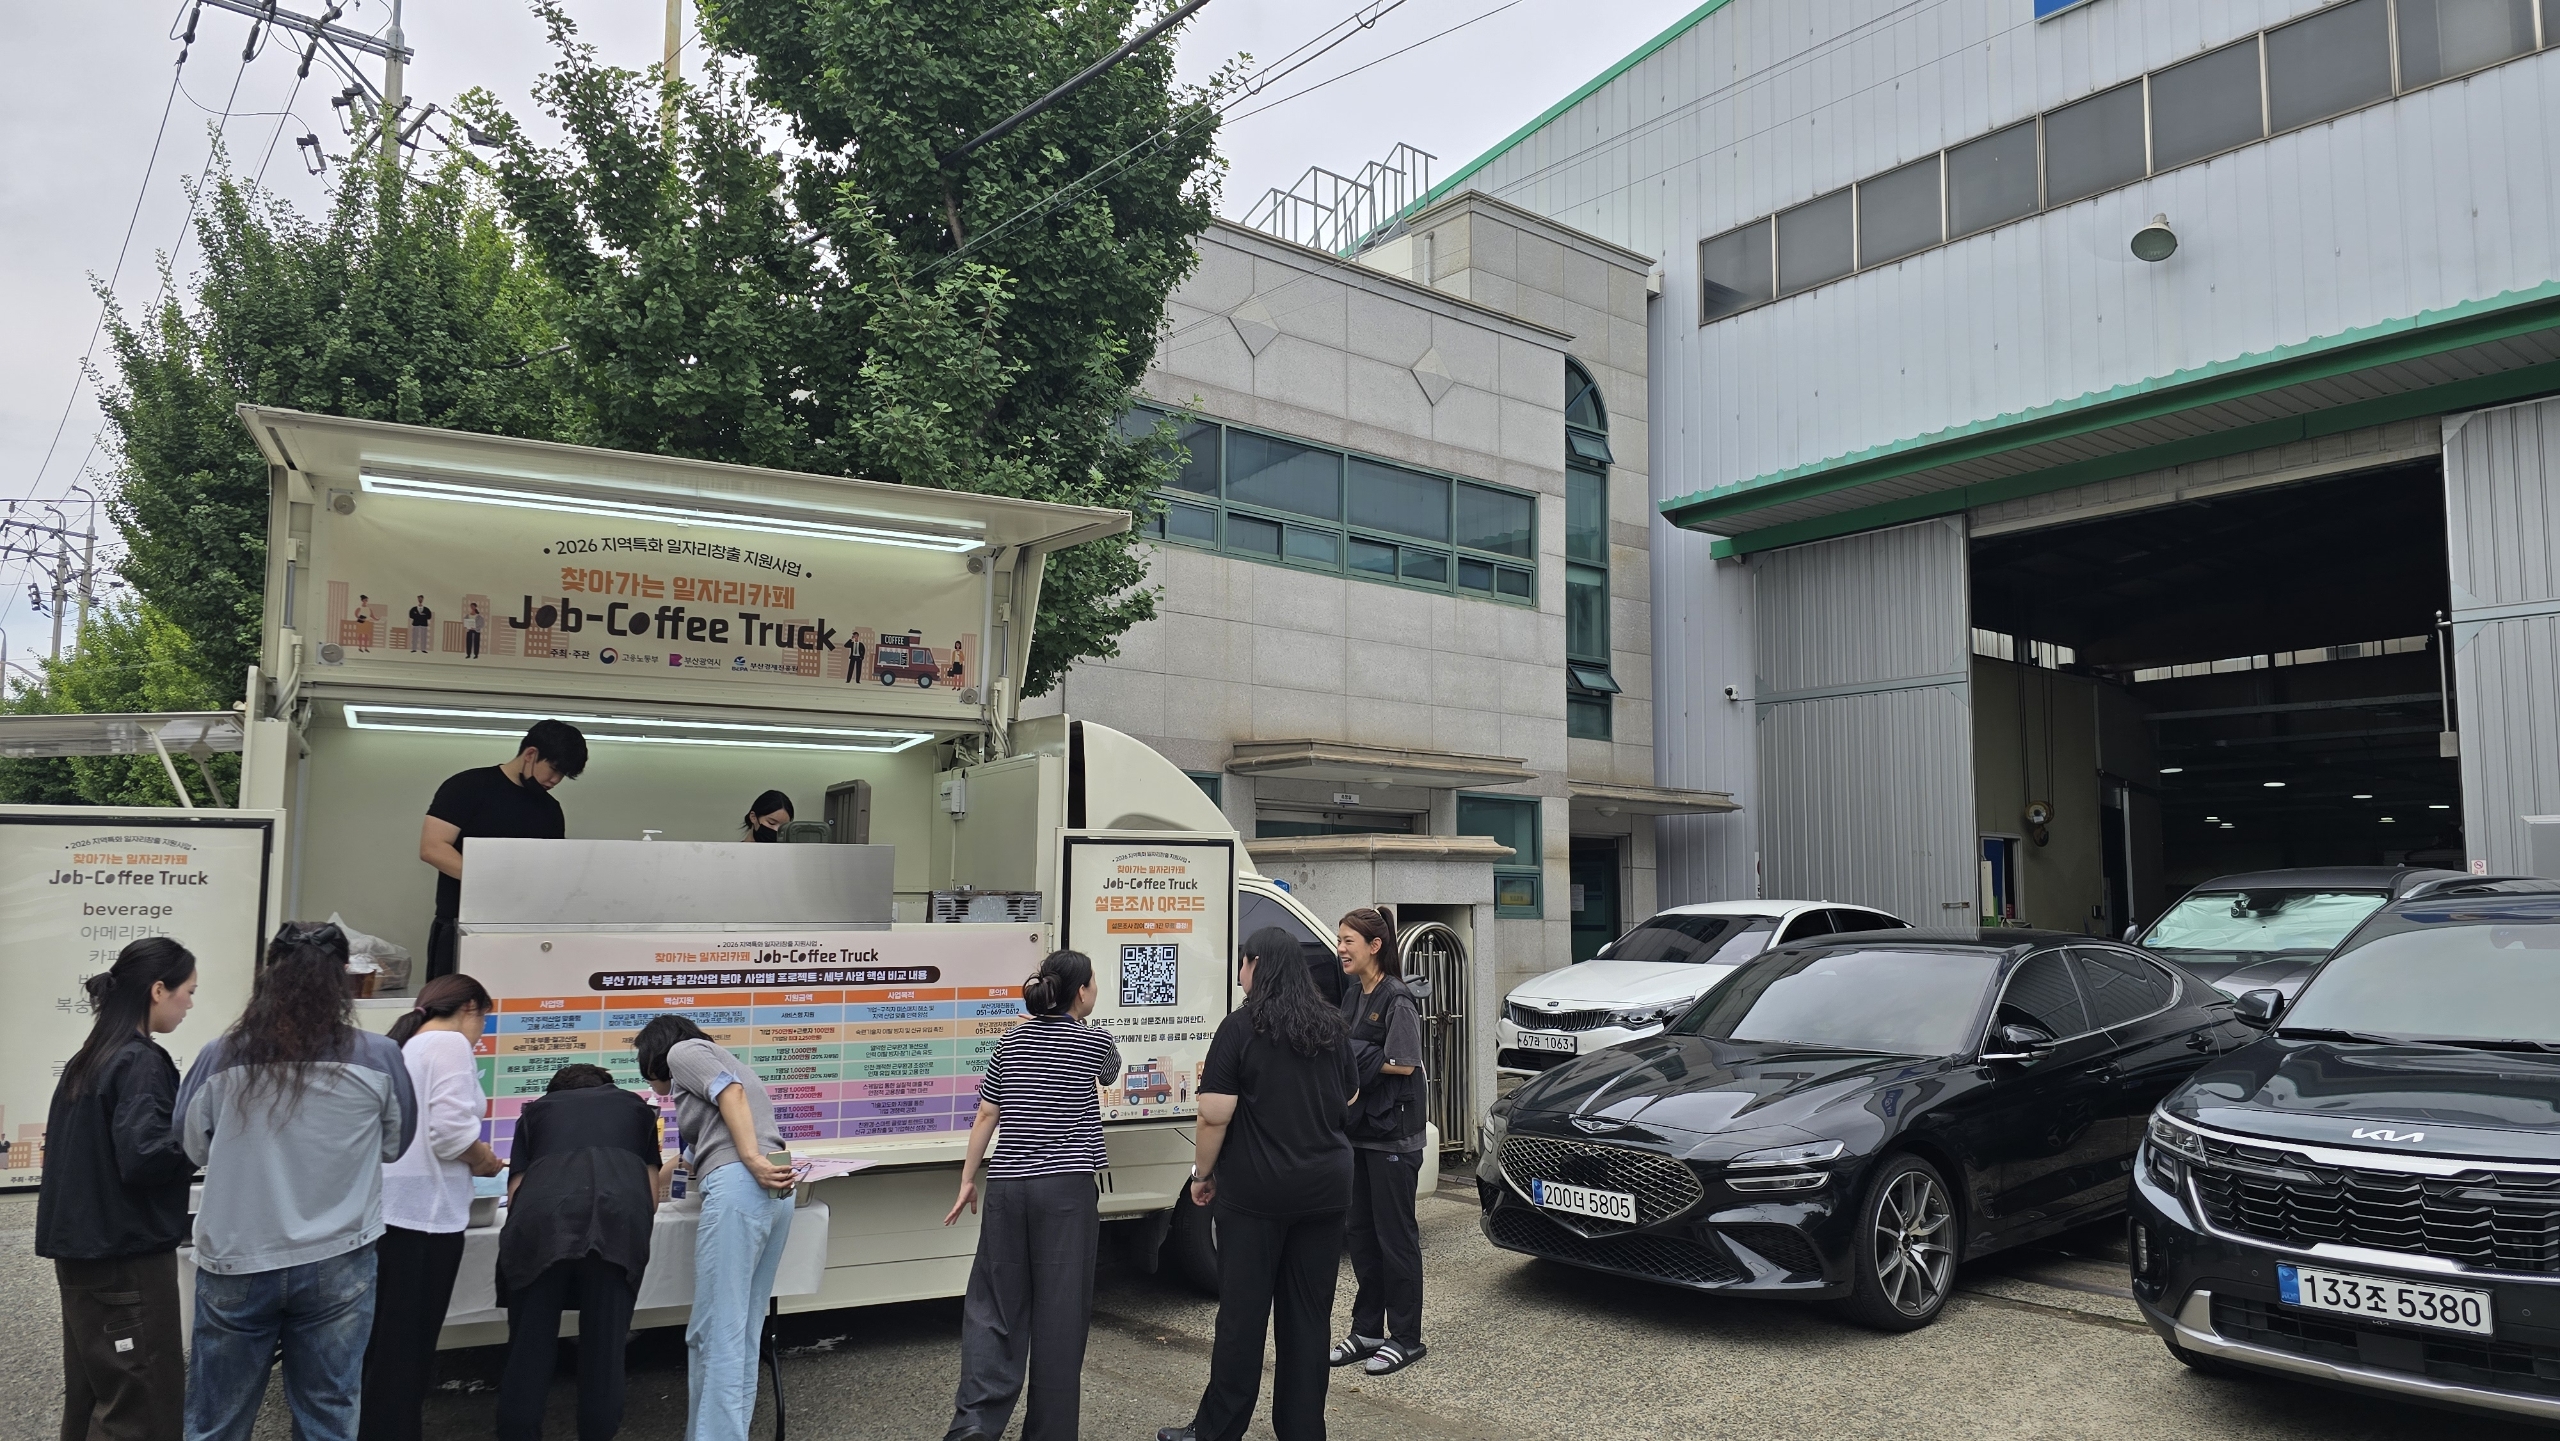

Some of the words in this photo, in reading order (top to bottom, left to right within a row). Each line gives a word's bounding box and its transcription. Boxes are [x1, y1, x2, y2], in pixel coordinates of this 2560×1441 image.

[557, 538, 598, 556] 2026
[602, 536, 664, 554] 지역특화
[668, 538, 741, 563] 일자리창출
[743, 550, 802, 578] 지원사업
[561, 566, 665, 599] 찾아가는
[672, 575, 796, 610] 일자리카페
[509, 594, 729, 645] Job-Coffee
[738, 612, 837, 653] Truck
[884, 635, 905, 646] COFFEE
[622, 652, 660, 665] 고용노동부
[684, 655, 722, 667] 부산광역시
[73, 853, 123, 865] 찾아가는
[127, 854, 188, 865] 일자리카페
[49, 870, 154, 885] Job-Coffee
[159, 871, 209, 885] Truck
[1117, 865, 1147, 874] 찾아가는
[1149, 865, 1186, 875] 일자리카페
[1103, 877, 1166, 890] Job-Coffee
[1168, 878, 1198, 890] Truck
[83, 902, 173, 919] beverage
[1095, 896, 1155, 912] 설문조사
[1157, 896, 1205, 913] QR코드
[80, 925, 170, 941] 아메리카노
[655, 952, 697, 964] 찾아가는
[699, 951, 751, 963] 일자리카페
[754, 949, 837, 964] Job-Coffee
[840, 948, 879, 963] Truck
[602, 975, 625, 987] 부산
[720, 973, 742, 985] 분야
[744, 972, 776, 984] 사업별
[777, 971, 818, 983] 프로젝트
[823, 971, 844, 982] 세부
[845, 970, 865, 982] 사업
[866, 970, 886, 981] 핵심
[888, 970, 907, 981] 비교
[908, 969, 928, 981] 내용
[663, 996, 695, 1005] 핵심지원
[976, 1008, 1020, 1016] 051-669-0612
[1522, 1035, 1541, 1048] 67라
[1545, 1036, 1570, 1050] 1063
[1589, 1192, 1631, 1219] 5805
[2303, 1274, 2388, 1314] 133조
[2397, 1287, 2482, 1328] 5380
